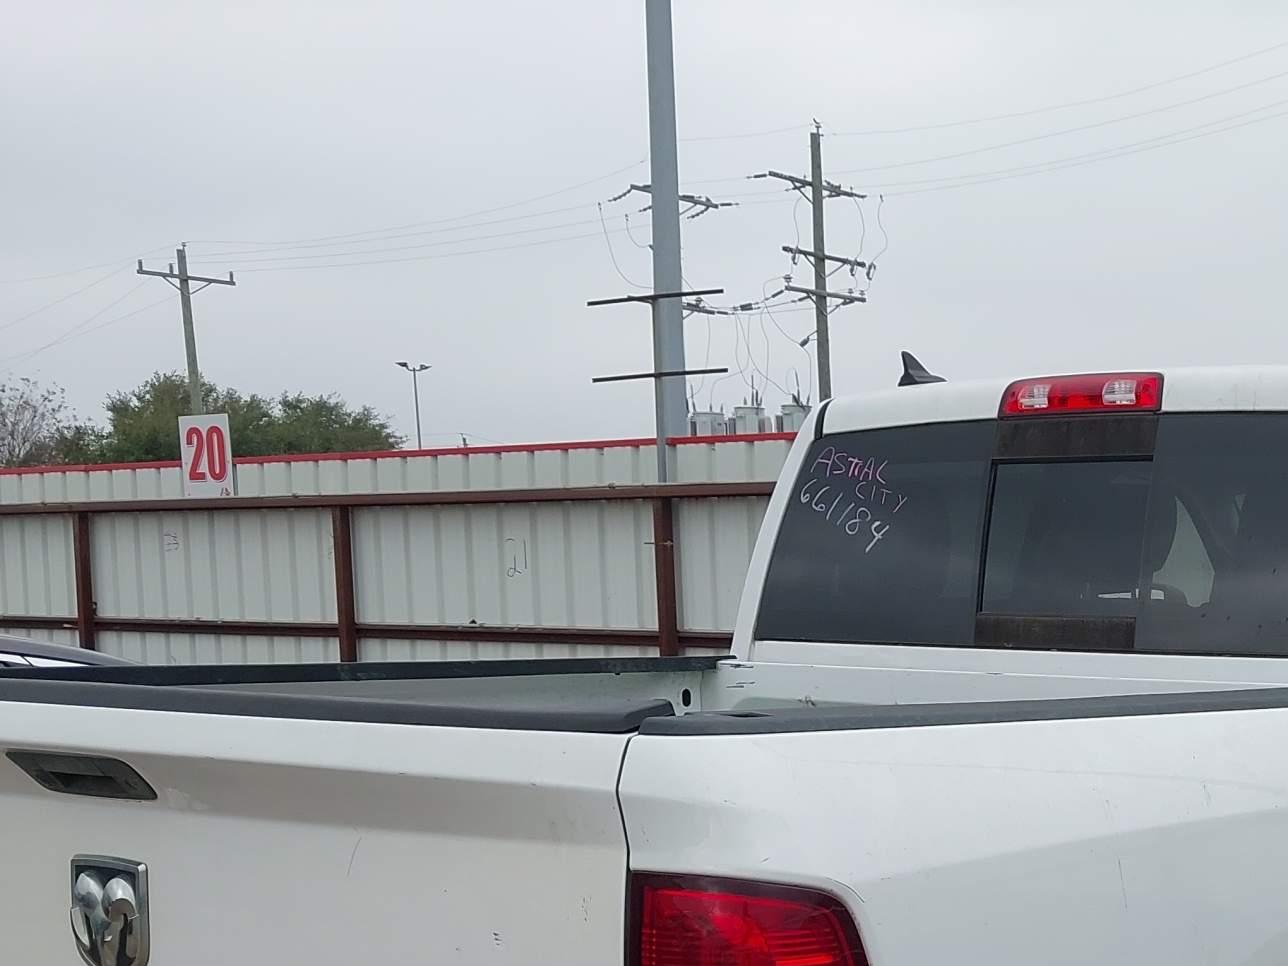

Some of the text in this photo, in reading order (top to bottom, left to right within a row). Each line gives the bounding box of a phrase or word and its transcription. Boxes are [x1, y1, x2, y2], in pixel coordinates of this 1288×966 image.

[185, 425, 228, 482] 20
[800, 478, 890, 553] 661184
[855, 481, 908, 513] CITY
